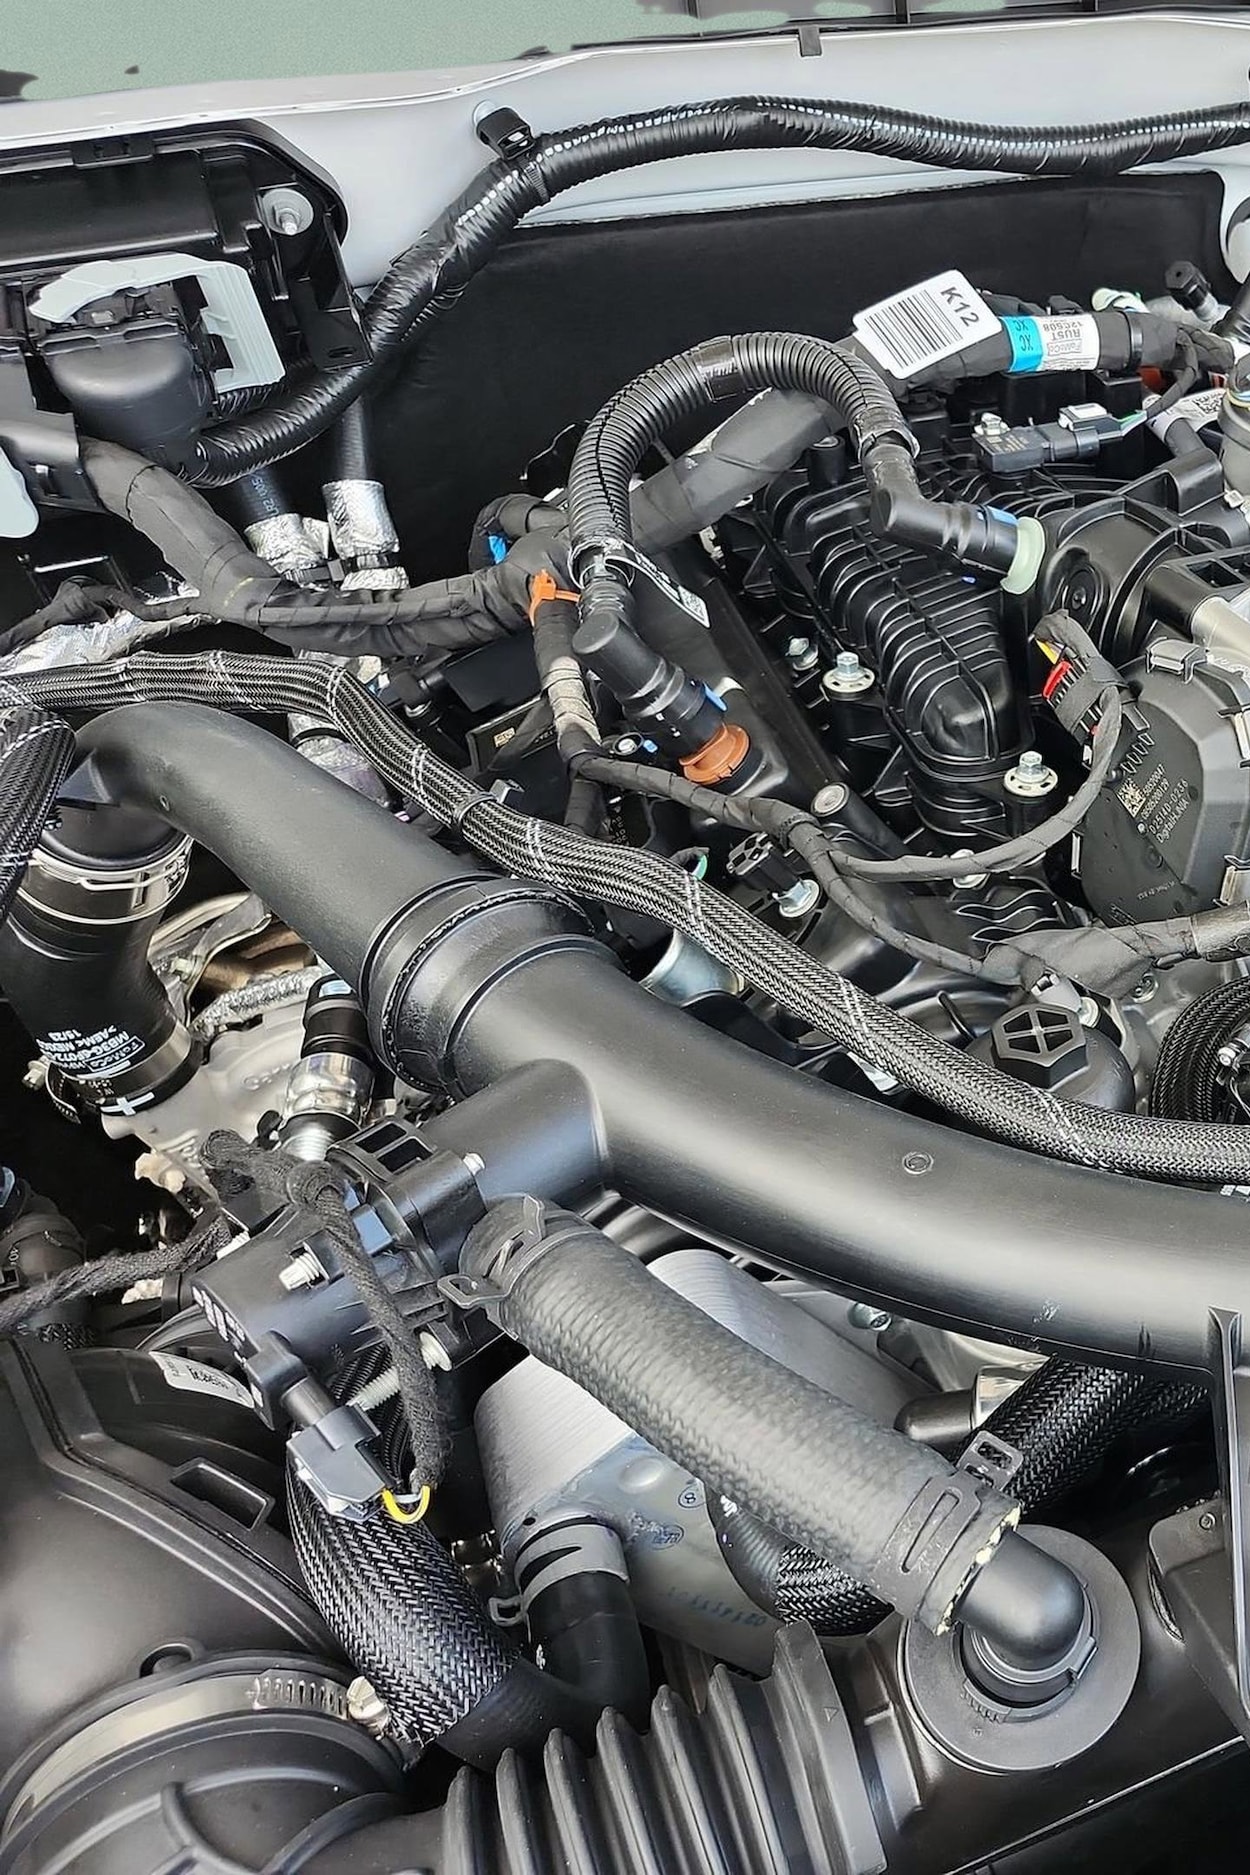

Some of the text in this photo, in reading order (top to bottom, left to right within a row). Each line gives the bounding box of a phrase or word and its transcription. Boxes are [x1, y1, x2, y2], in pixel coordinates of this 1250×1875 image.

[940, 286, 980, 328] K12
[1018, 334, 1033, 351] XC
[88, 1041, 140, 1067] FoMoCo
